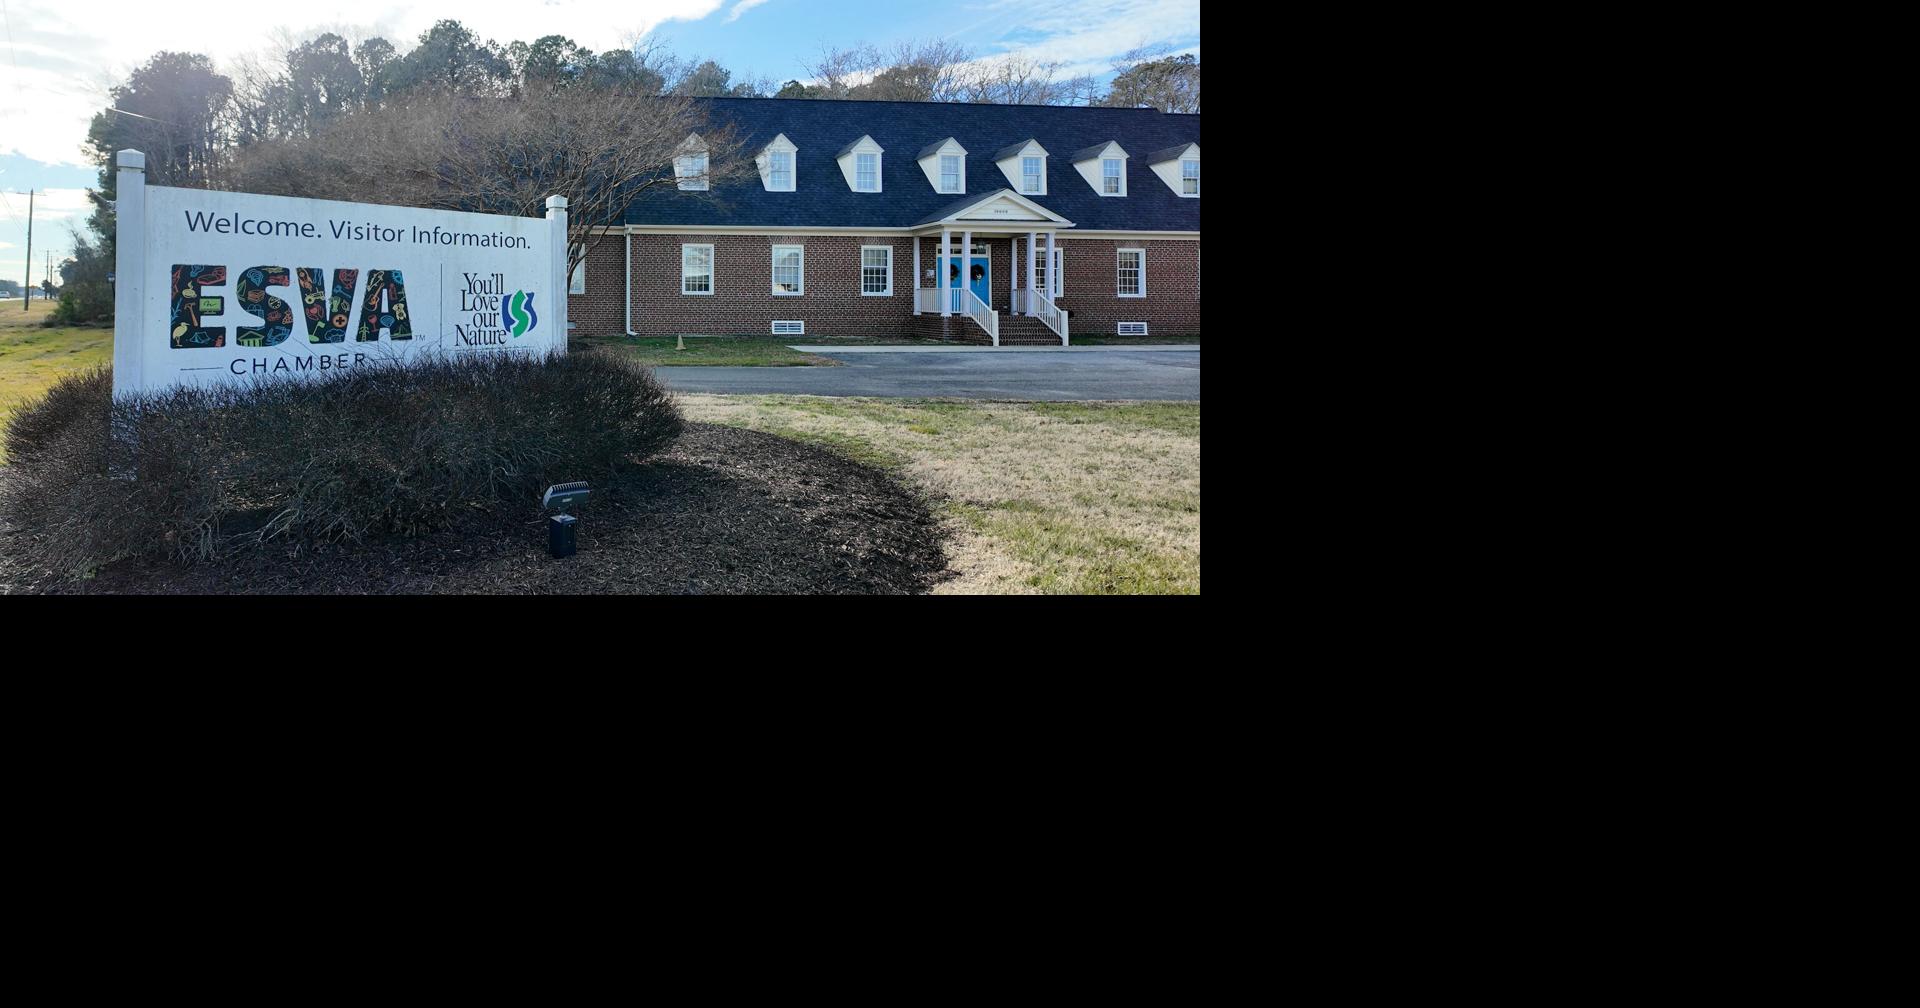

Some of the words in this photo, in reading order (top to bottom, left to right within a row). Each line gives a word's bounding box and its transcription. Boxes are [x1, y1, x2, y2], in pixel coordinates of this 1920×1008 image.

[184, 210, 322, 238] Welcome.
[329, 219, 405, 243] Visitor
[412, 225, 531, 250] Information.
[463, 272, 504, 295] You'll
[170, 264, 413, 349] ESVA
[460, 289, 499, 312] Love
[472, 311, 500, 328] our
[454, 323, 507, 347] Nature
[230, 352, 366, 375] CHAMBER
